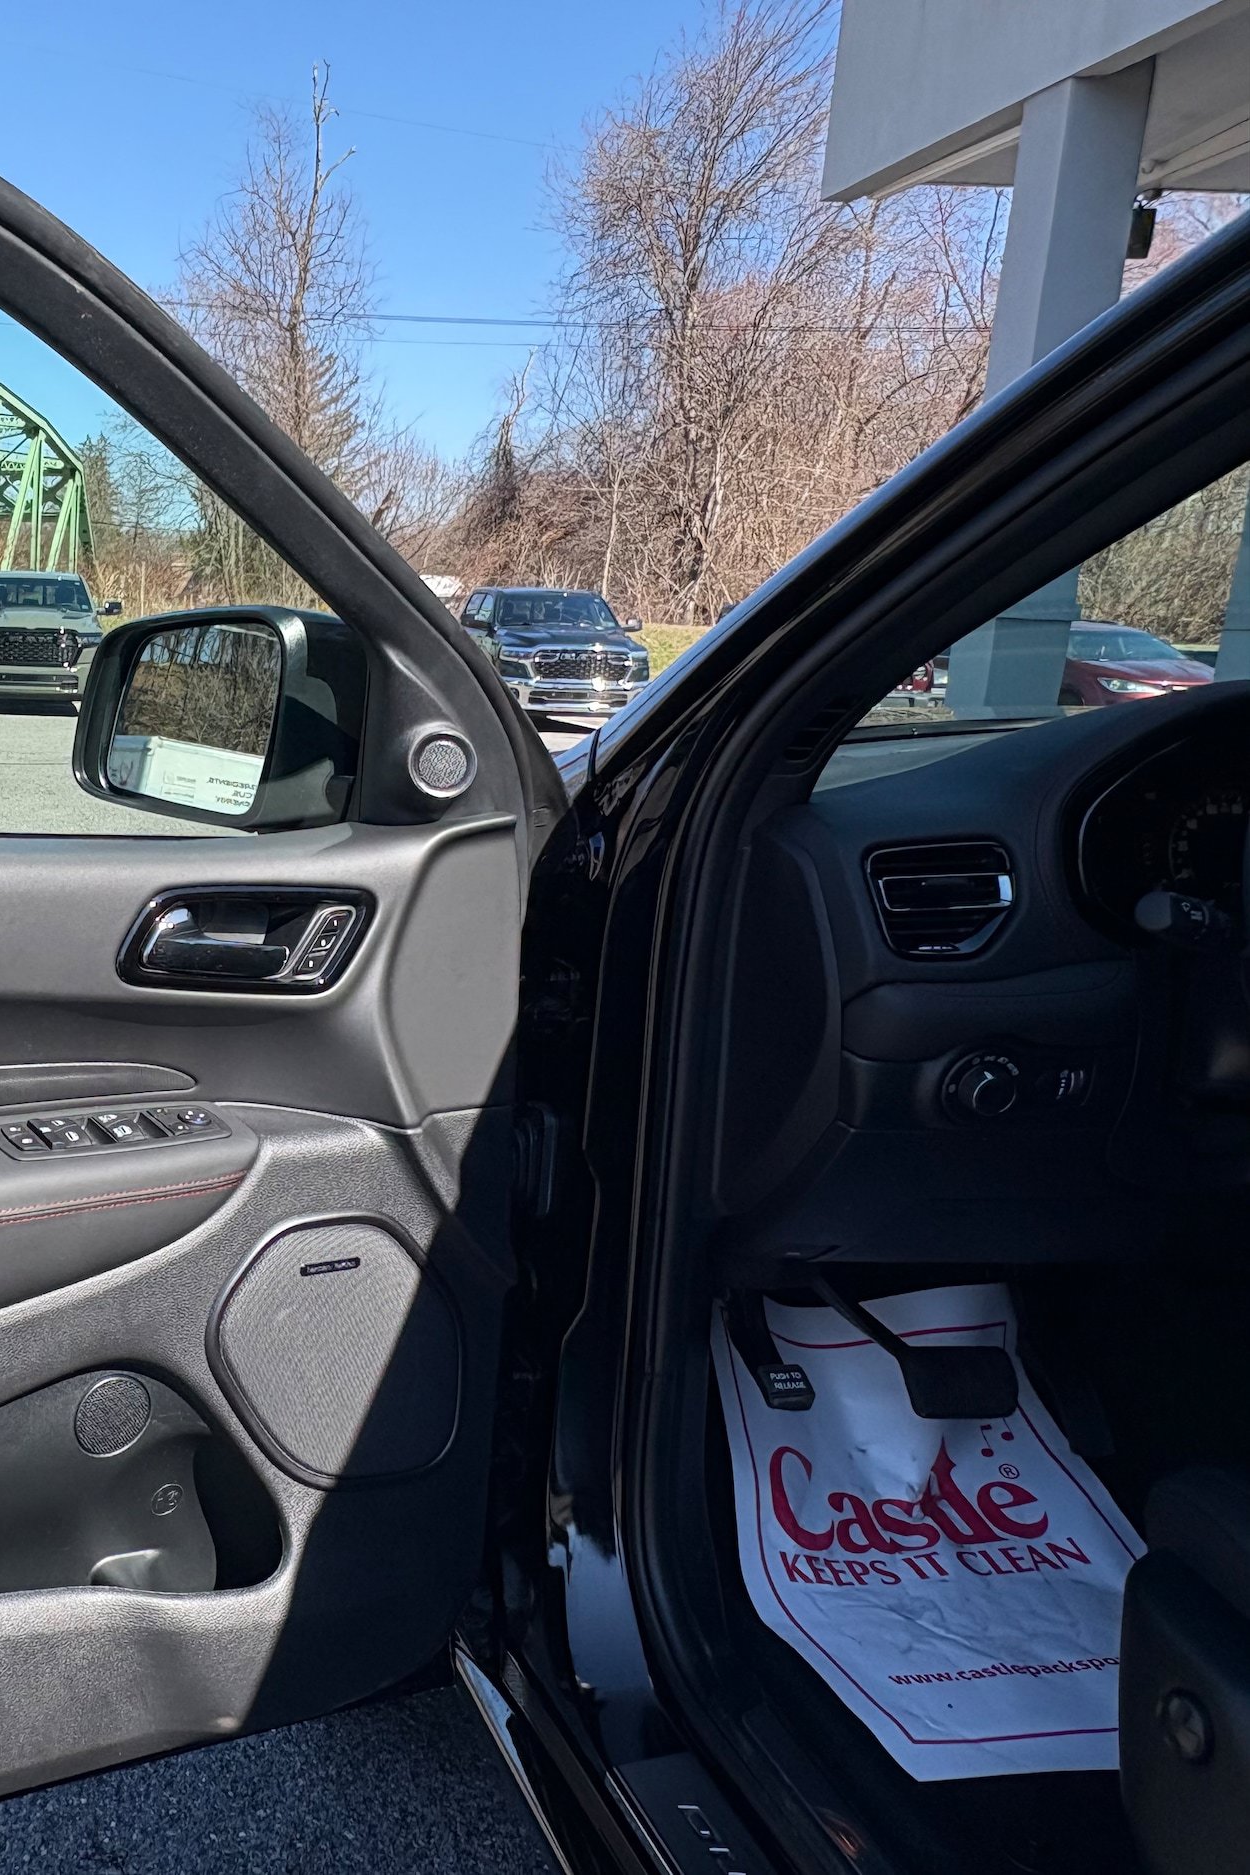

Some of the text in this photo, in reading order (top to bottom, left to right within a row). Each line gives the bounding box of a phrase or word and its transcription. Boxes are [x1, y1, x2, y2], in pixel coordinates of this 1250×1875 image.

[769, 1371, 802, 1380] PUSH TO
[779, 1537, 1092, 1586] KEEPS IT CLEAN
[887, 1656, 1119, 1686] www.castlepackspo
